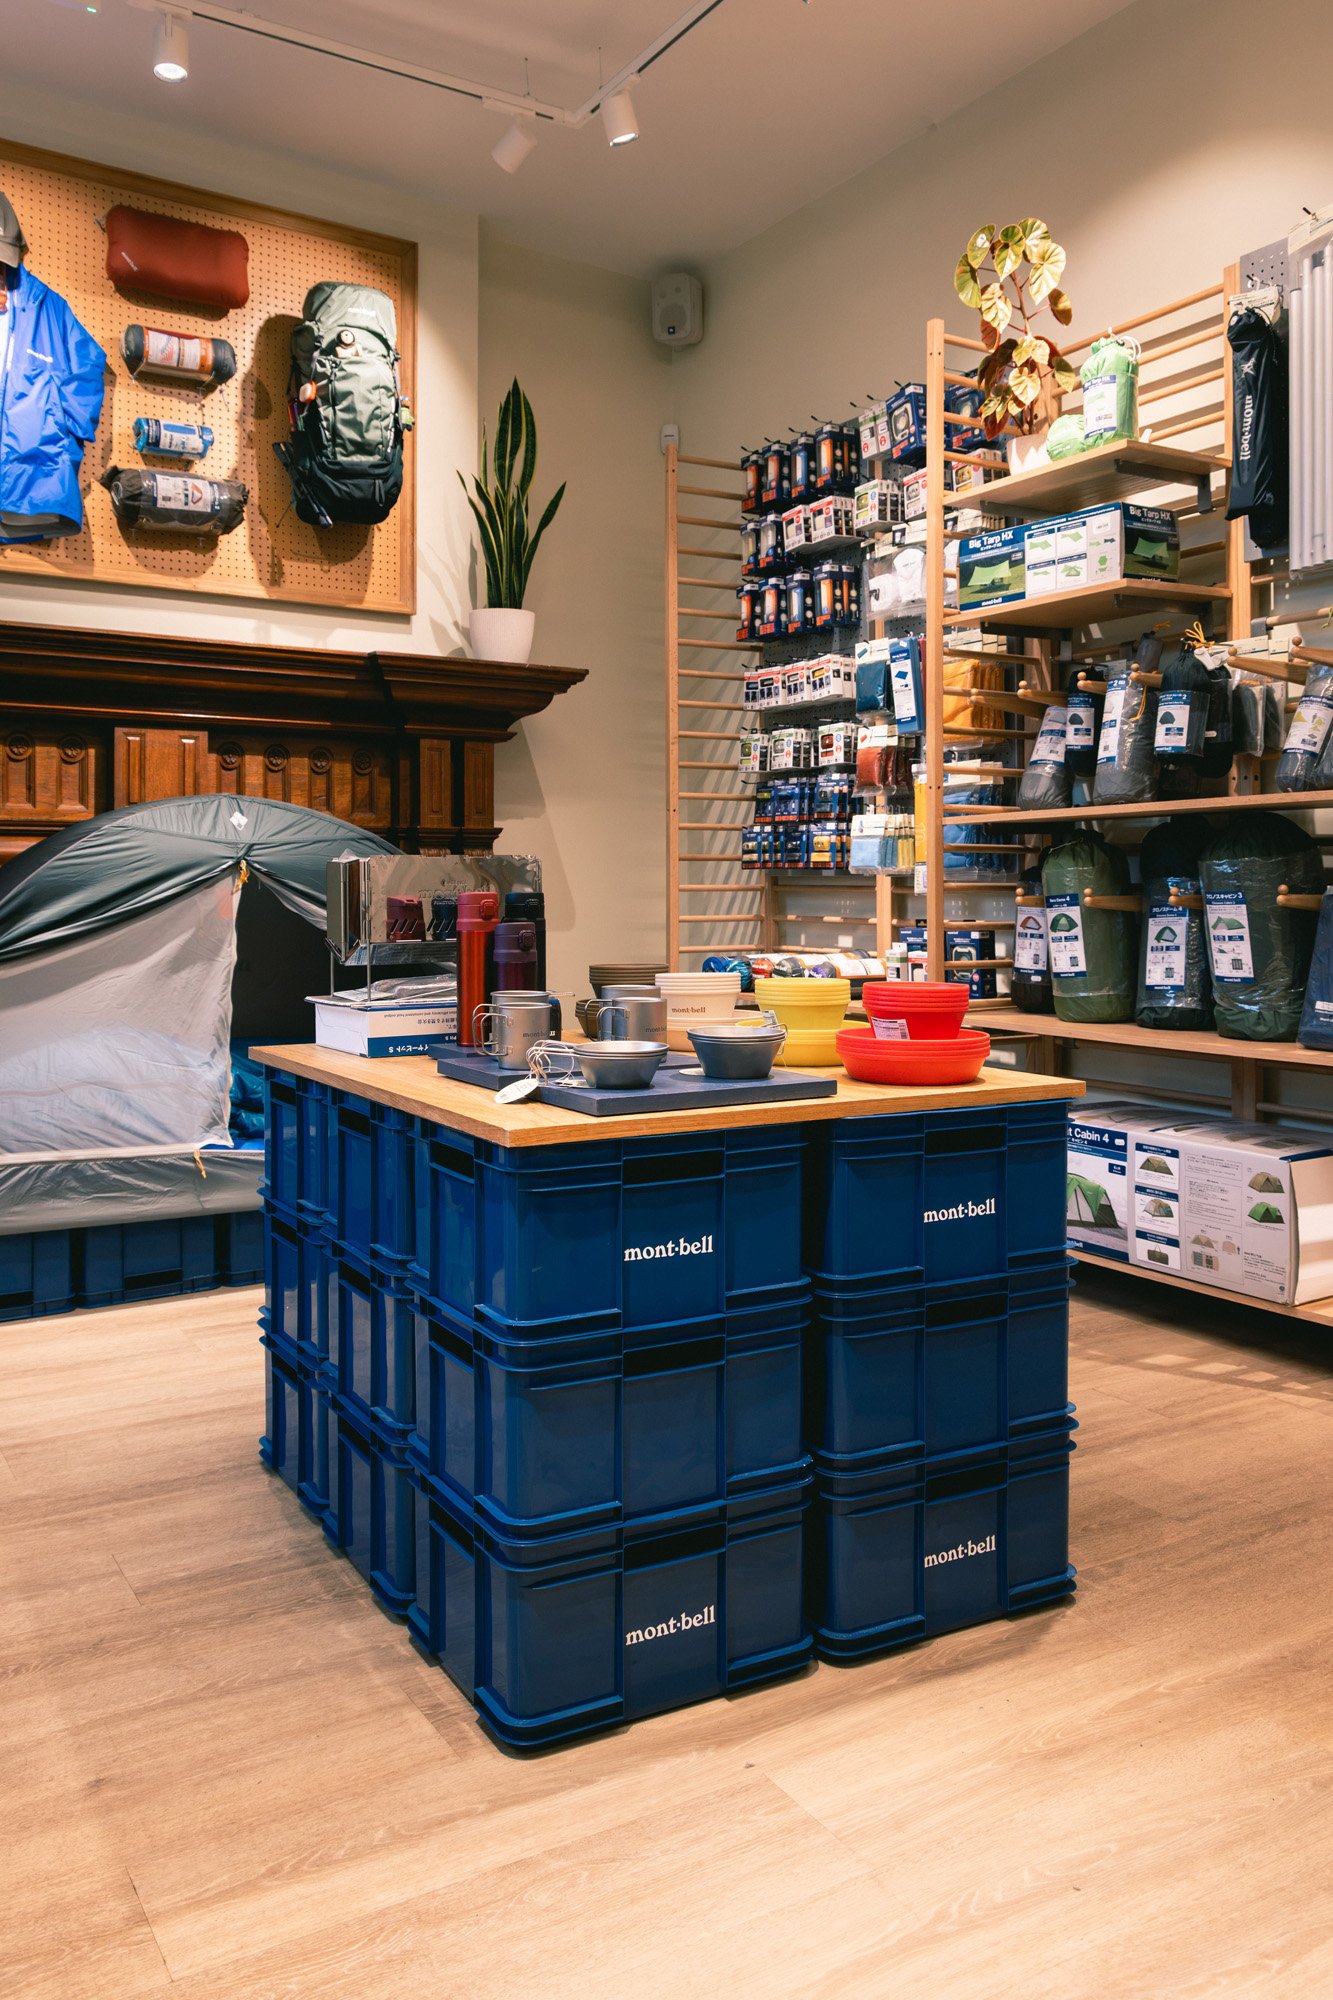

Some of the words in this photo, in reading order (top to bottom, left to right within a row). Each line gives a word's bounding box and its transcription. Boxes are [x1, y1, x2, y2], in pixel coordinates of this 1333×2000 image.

[1129, 505, 1142, 517] Big
[1142, 508, 1160, 519] Tarp
[1160, 511, 1171, 520] HX
[968, 539, 981, 549] Big
[982, 535, 1001, 546] Tarp
[1001, 530, 1014, 541] HX
[1237, 891, 1243, 899] 3
[1074, 1128, 1101, 1142] Cabin
[1102, 1133, 1110, 1143] 4
